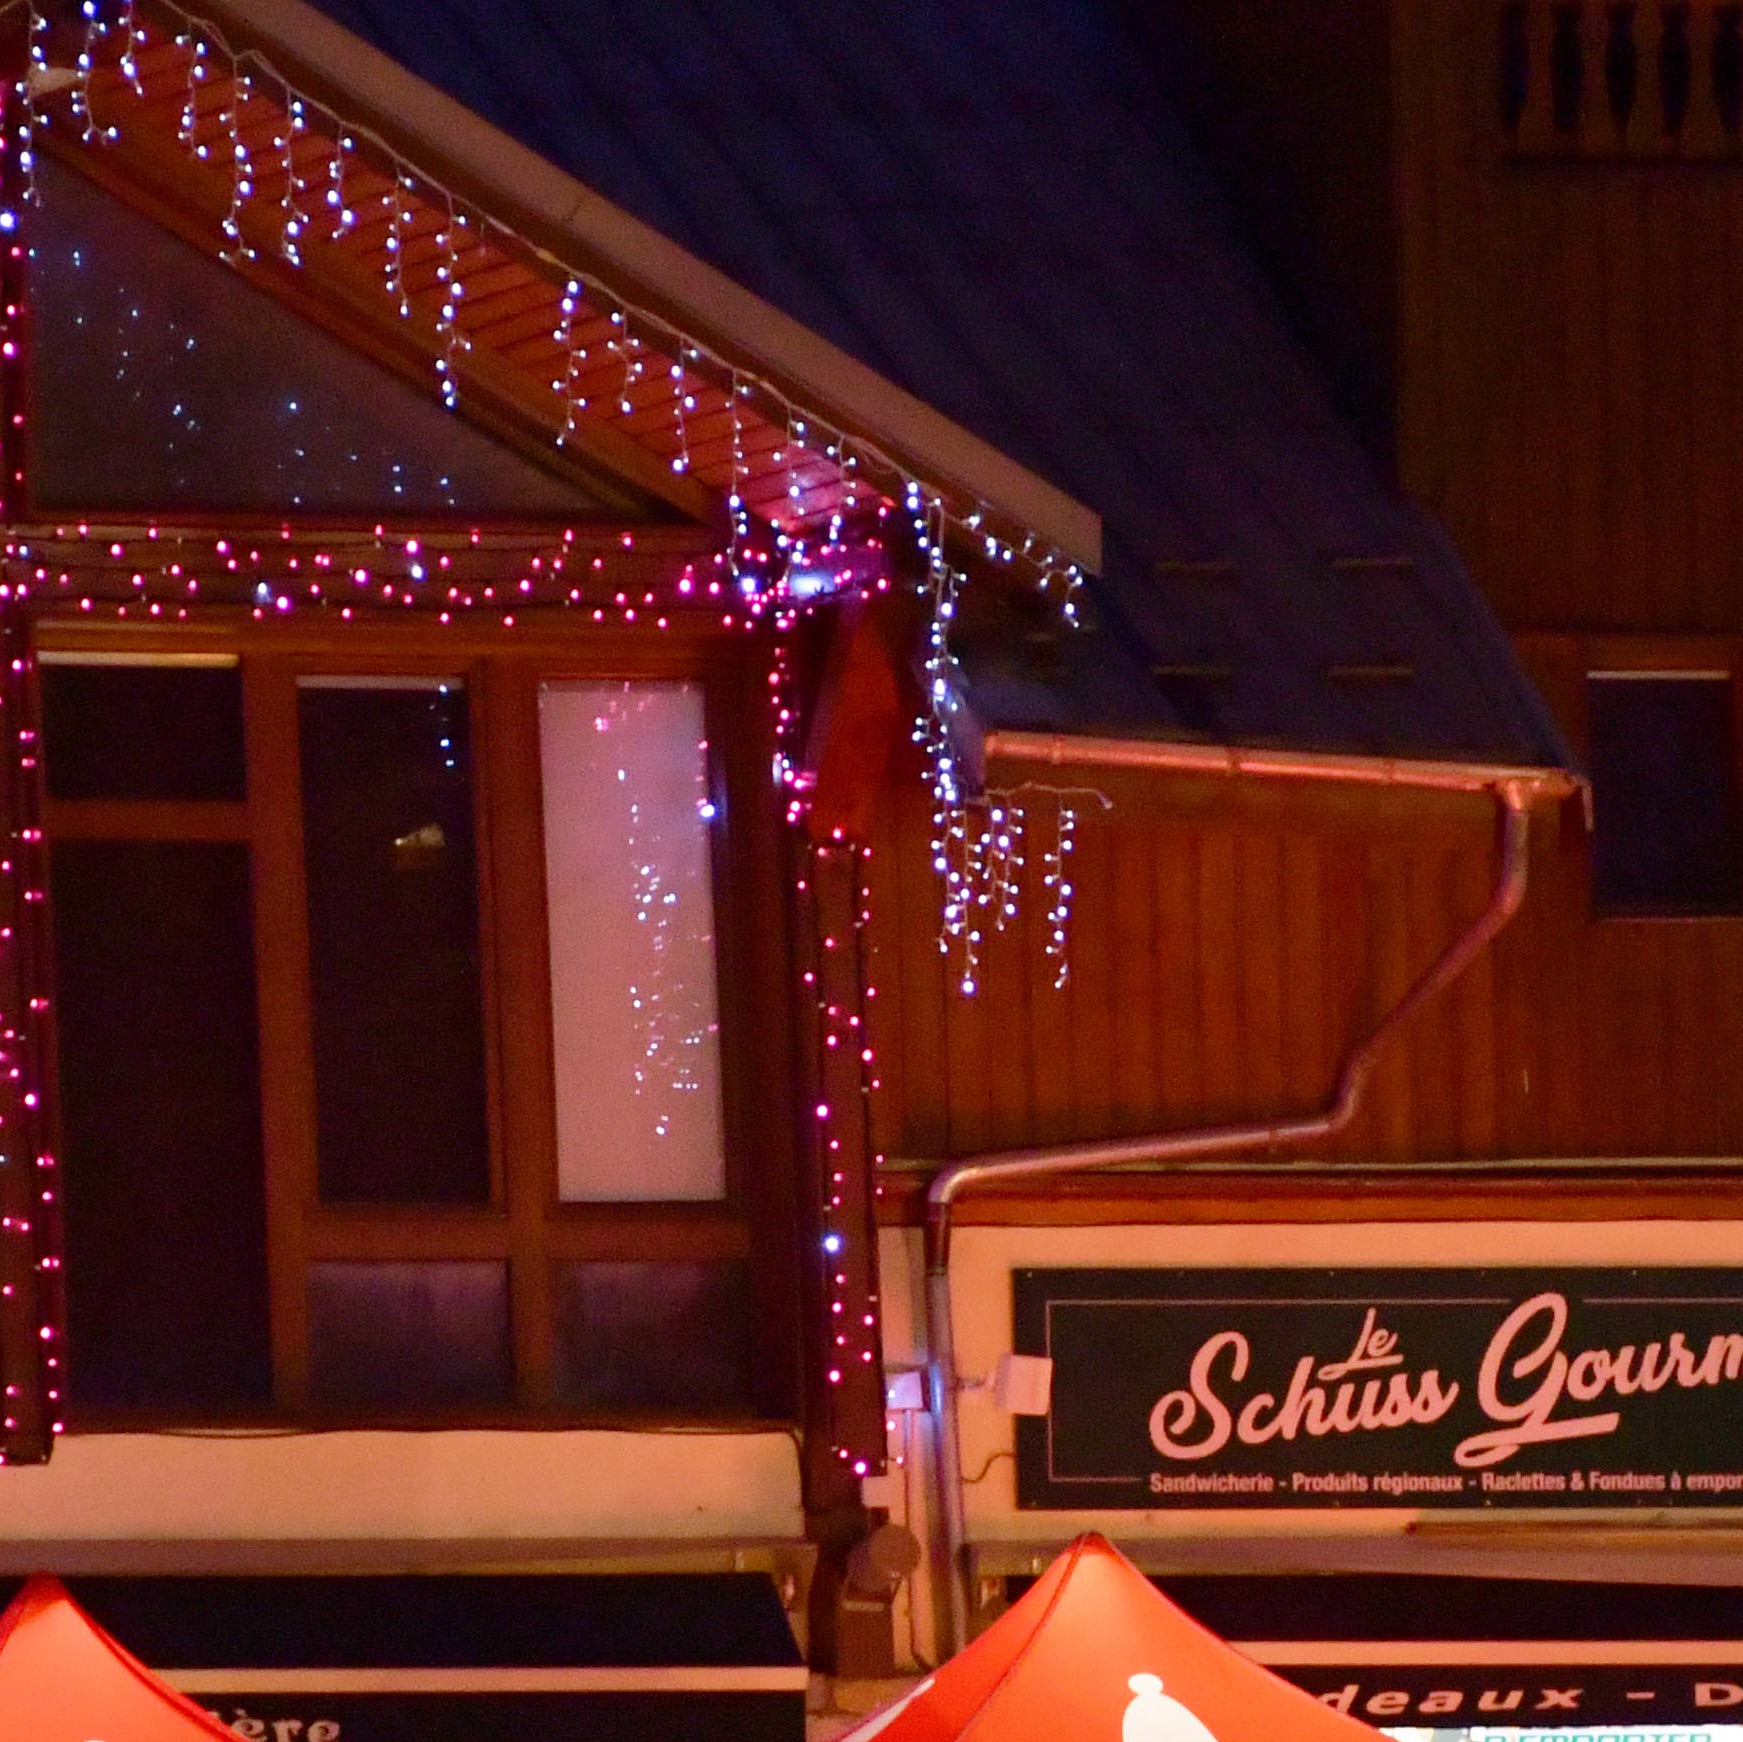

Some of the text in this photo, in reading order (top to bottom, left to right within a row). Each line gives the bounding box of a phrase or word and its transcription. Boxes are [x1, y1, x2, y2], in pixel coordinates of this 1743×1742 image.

[1318, 1306, 1403, 1381] Le
[1149, 1330, 1459, 1460] Schuss
[1149, 1472, 1274, 1494] Sandwicherie
[1292, 1472, 1369, 1493] Produits
[1373, 1471, 1463, 1496] régionaux
[1482, 1471, 1566, 1491] Raclettes
[1570, 1471, 1586, 1491] &
[1589, 1471, 1666, 1491] Fondues
